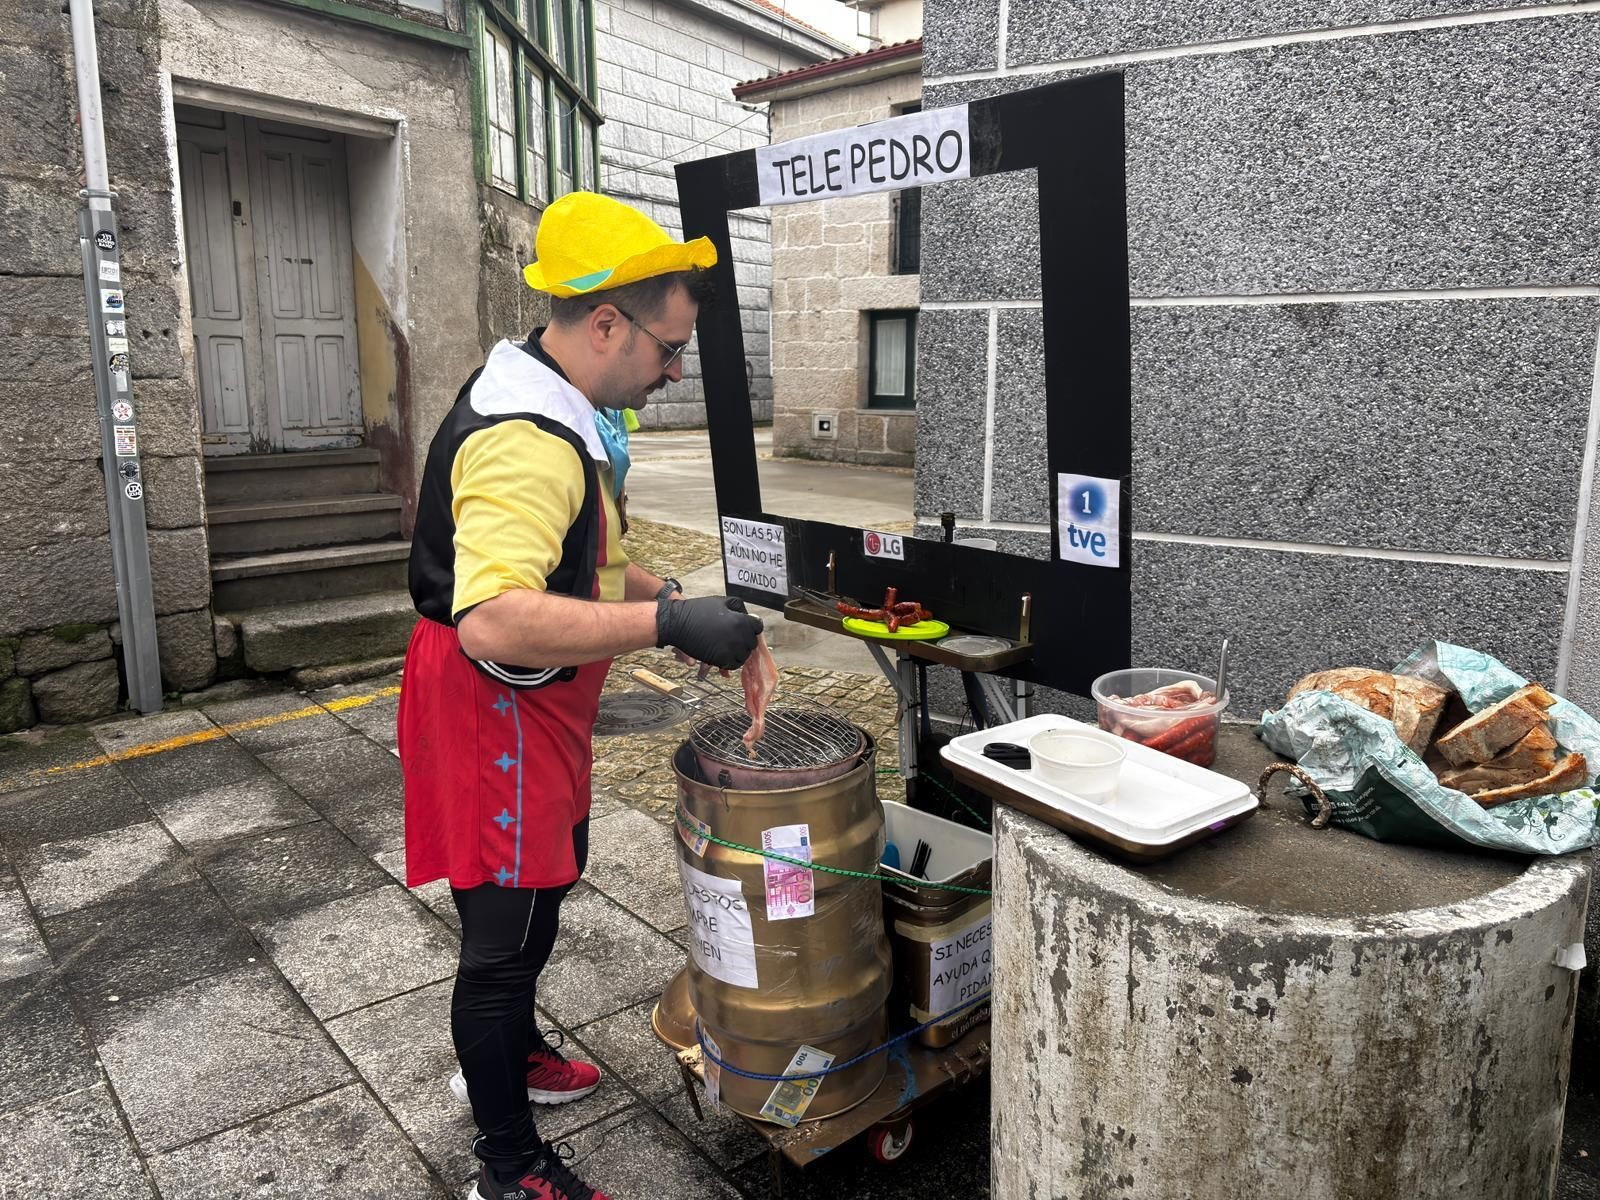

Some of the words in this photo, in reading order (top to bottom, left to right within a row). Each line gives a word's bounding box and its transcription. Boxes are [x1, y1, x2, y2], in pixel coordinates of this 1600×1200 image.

[772, 149, 842, 196] TELE
[850, 129, 963, 185] PEDRO
[1081, 490, 1092, 514] 1
[723, 520, 744, 536] SON
[745, 524, 764, 539] LAS
[766, 528, 773, 542] 5
[774, 530, 782, 543] Y
[1067, 522, 1106, 557] tve
[729, 543, 750, 560] AÚN
[751, 551, 767, 564] NO
[769, 554, 783, 568] HE
[883, 538, 901, 555] LG
[737, 569, 777, 589] COMIDO
[934, 944, 953, 961] SI
[933, 956, 978, 986] AYUDA
